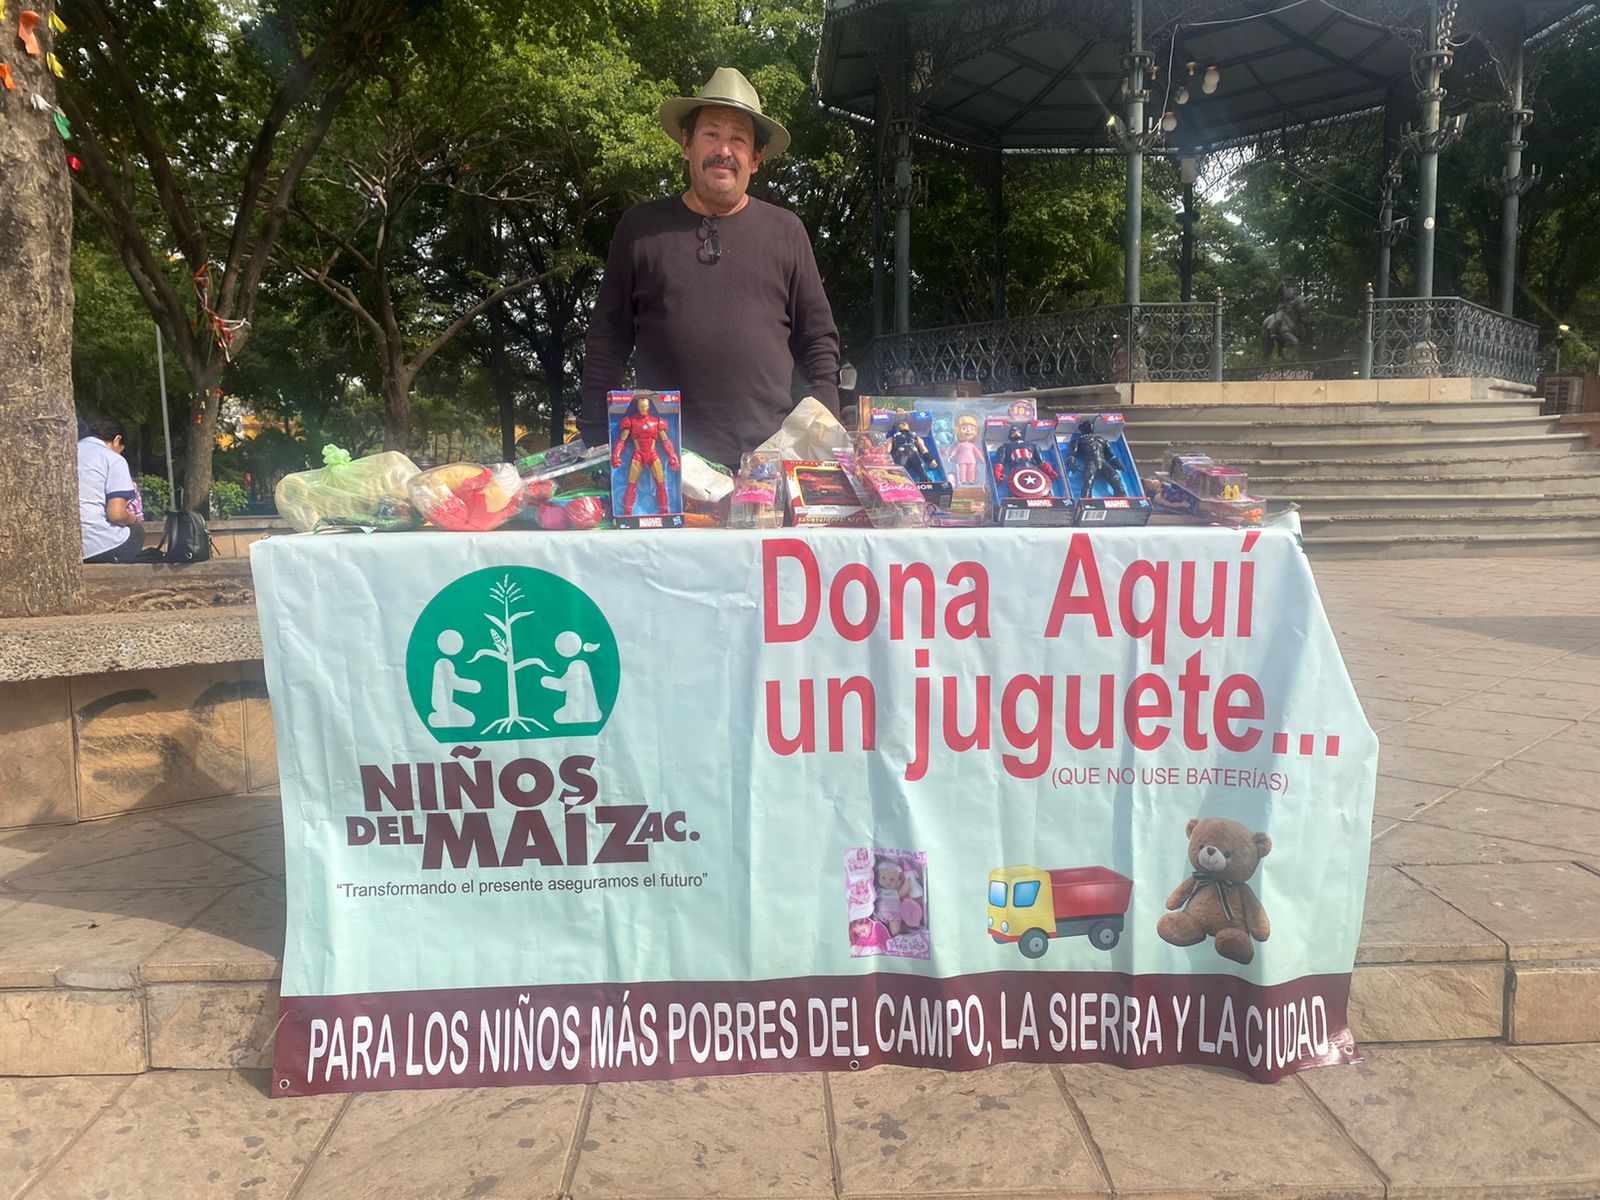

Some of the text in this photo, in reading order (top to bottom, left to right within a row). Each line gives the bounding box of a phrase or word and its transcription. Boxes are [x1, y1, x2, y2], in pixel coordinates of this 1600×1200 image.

[879, 482, 916, 492] Barbie
[1027, 499, 1053, 508] MARVEL
[1104, 499, 1131, 509] MARVEL
[639, 517, 663, 528] MARVEL
[762, 531, 1262, 665] Dona Aquí
[765, 649, 1340, 782] un juguete...
[360, 745, 599, 812] NIÑOS
[1052, 766, 1290, 795] (QUE NO USE BATERÍAS)
[345, 796, 701, 870] DEL MAÍZ AC.
[336, 872, 708, 899] “Transformando el presente aseguramos el futuro”
[307, 990, 1329, 1083] PARA LOS NIÑOS MÁS POBRES DEL CAMPO, LA SIERRA Y LA CIUDAD
